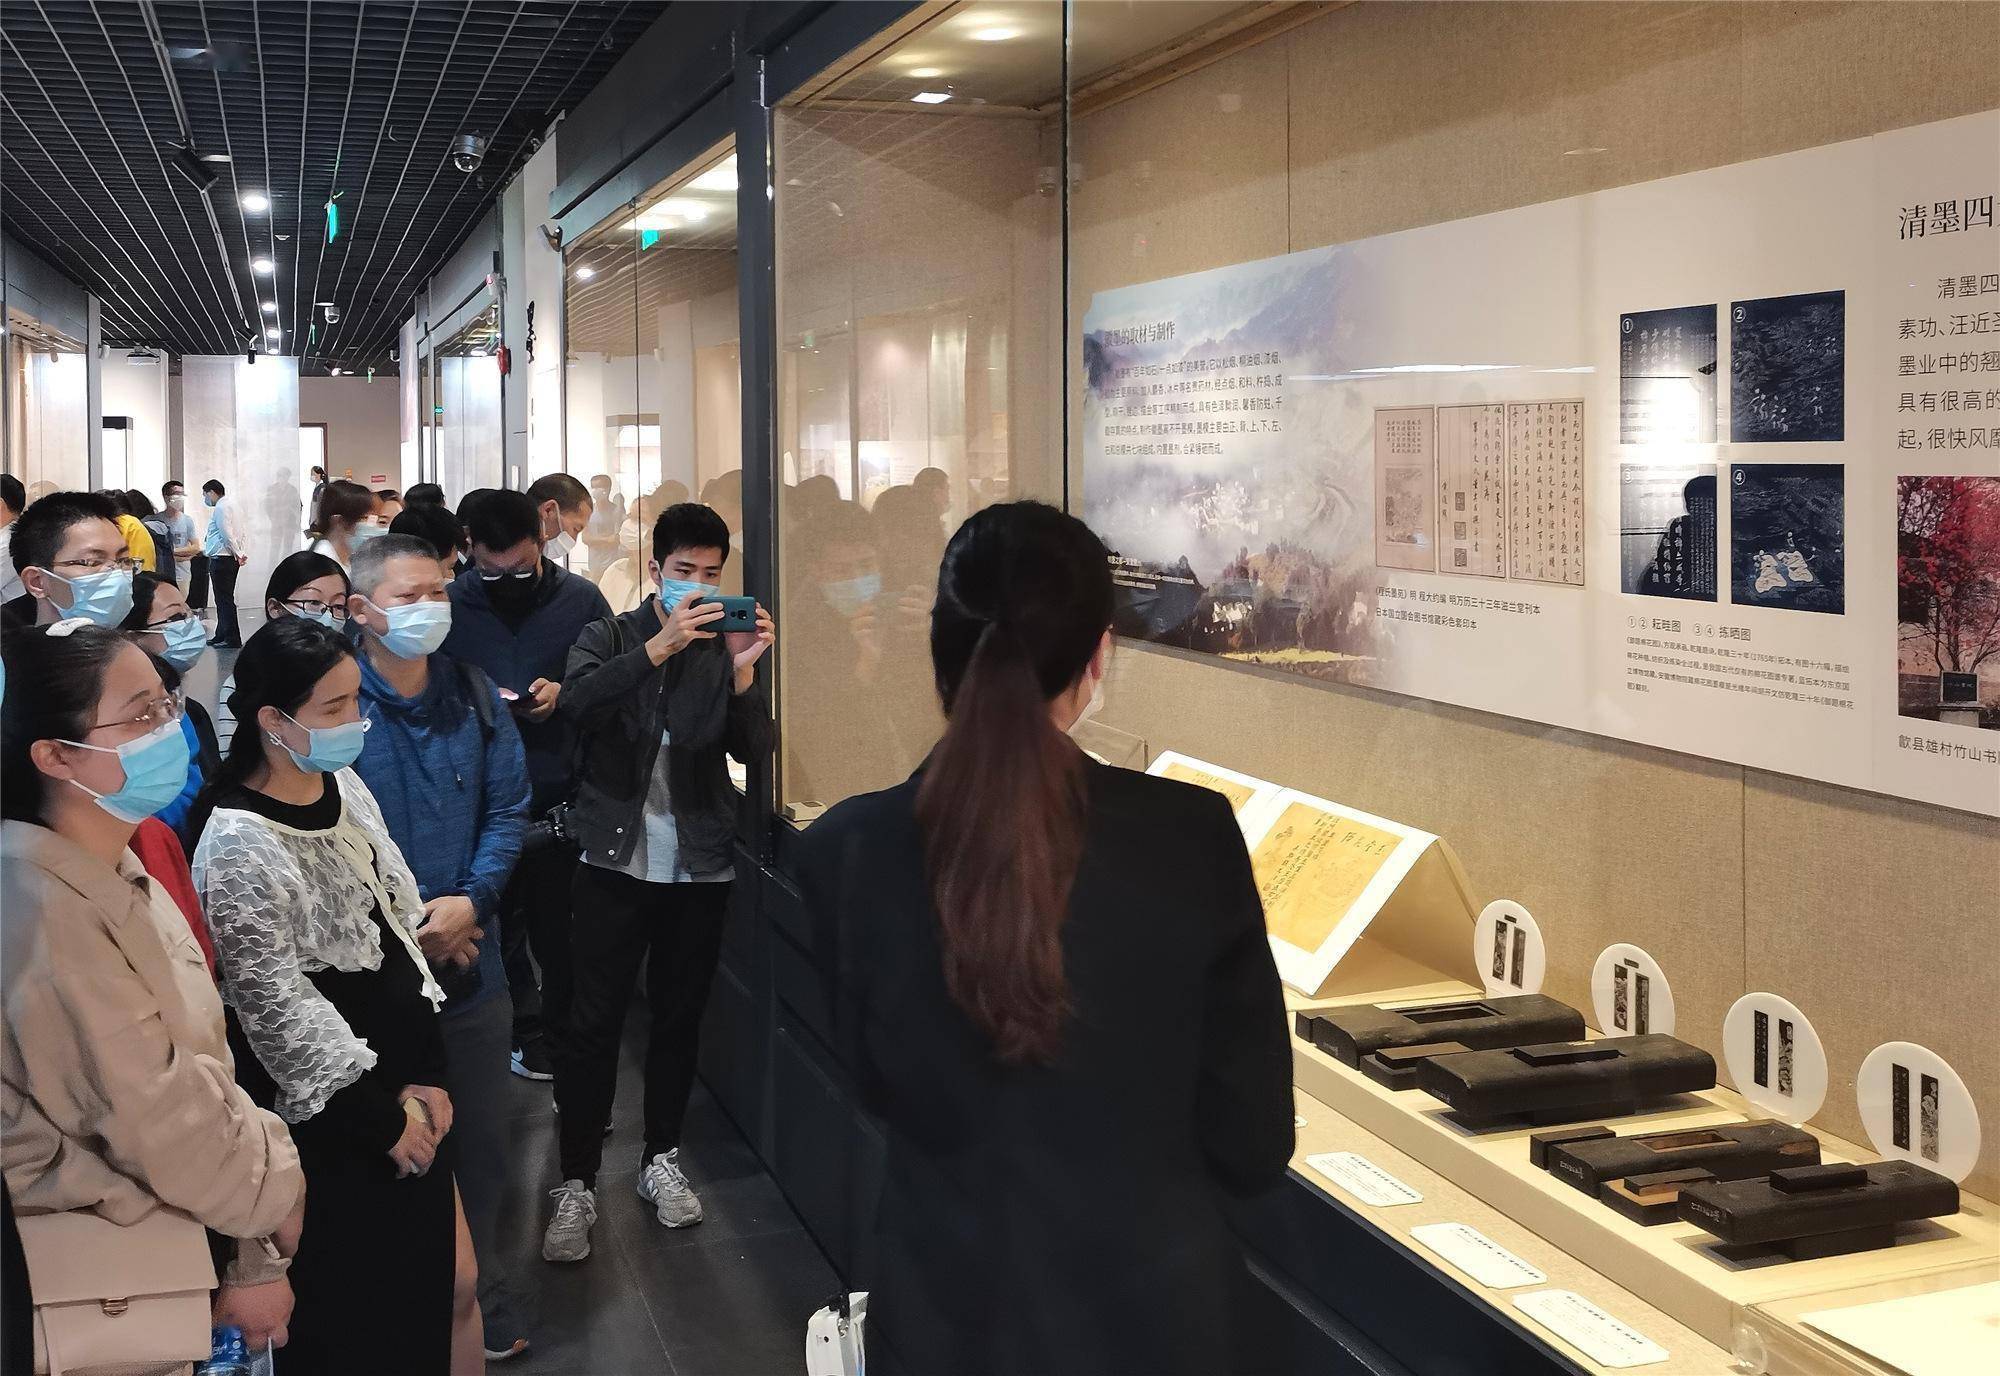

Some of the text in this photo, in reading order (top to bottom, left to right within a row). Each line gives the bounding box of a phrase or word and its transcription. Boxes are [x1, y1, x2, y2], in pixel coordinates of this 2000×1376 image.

[1899, 195, 2000, 240] 清墨四
[1937, 273, 2000, 300] 清墨四
[1898, 734, 2000, 764] 歙县雄村竹山书
